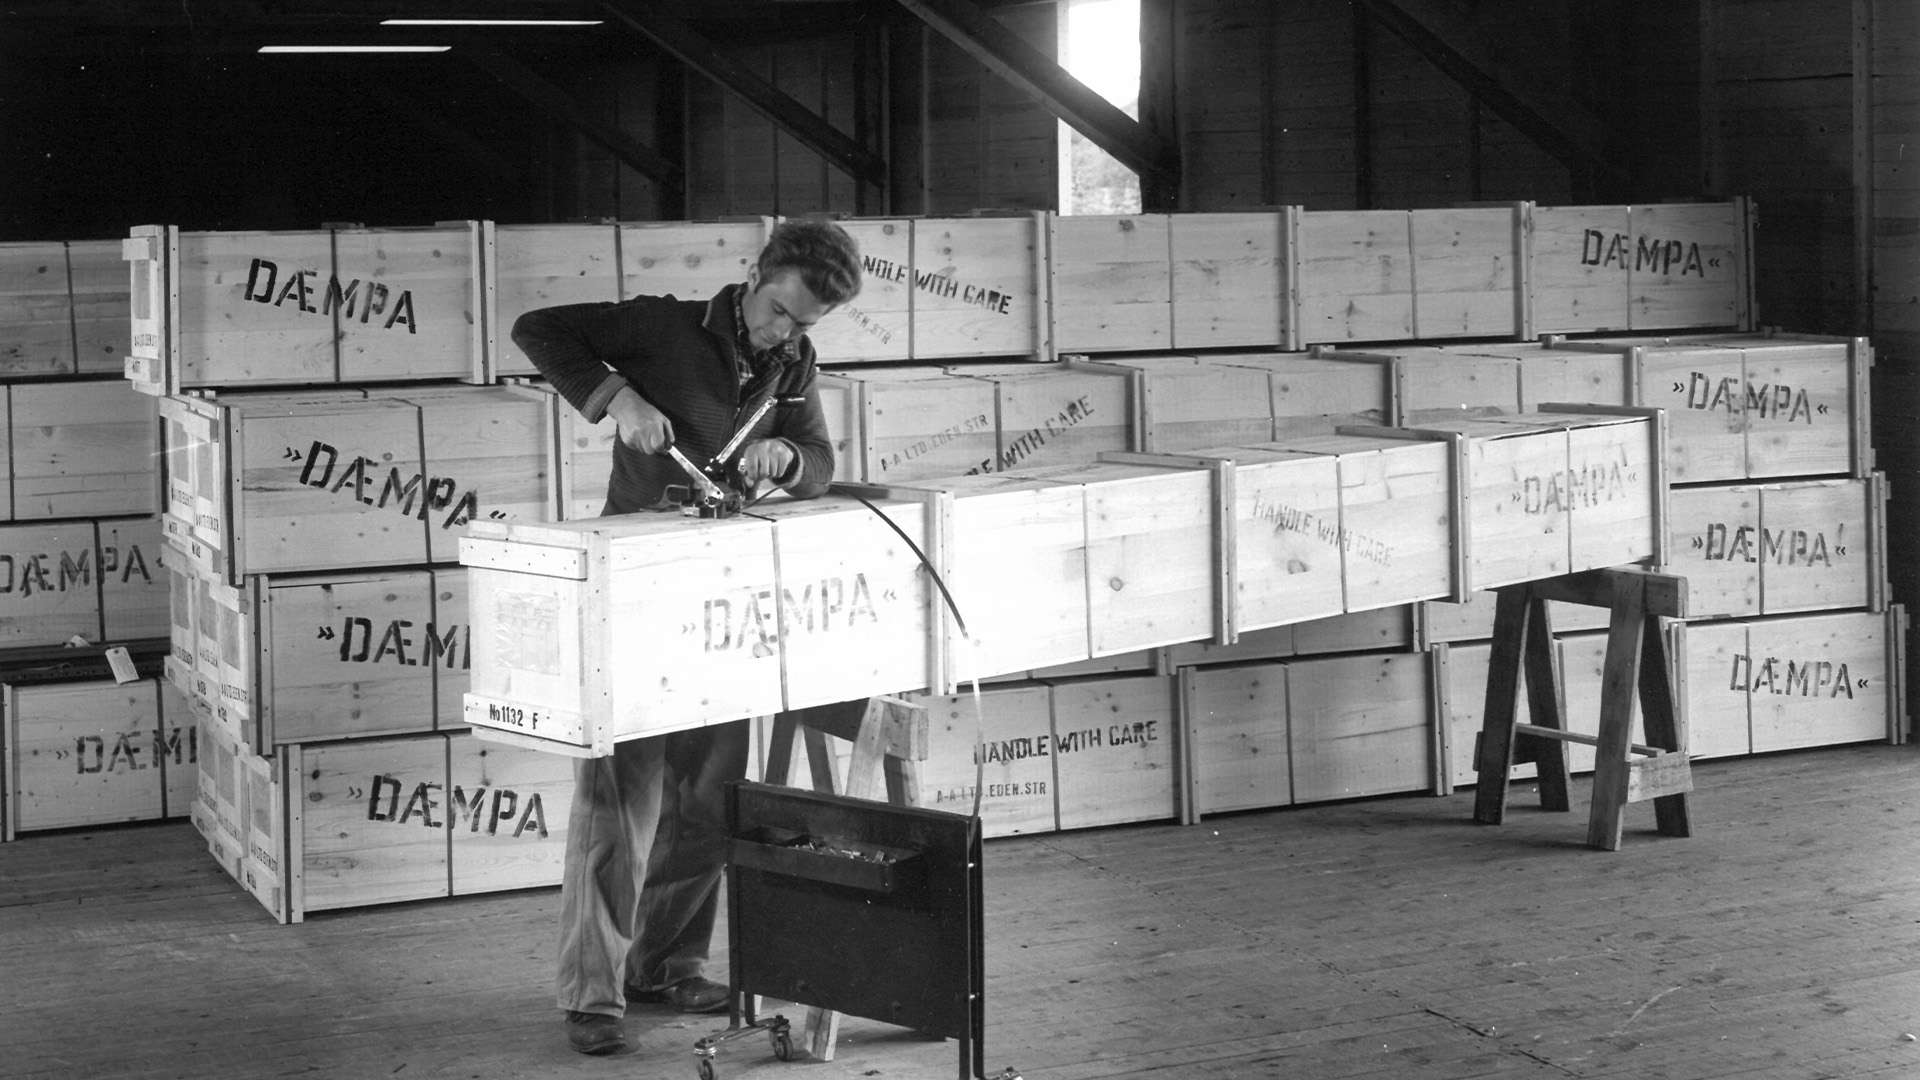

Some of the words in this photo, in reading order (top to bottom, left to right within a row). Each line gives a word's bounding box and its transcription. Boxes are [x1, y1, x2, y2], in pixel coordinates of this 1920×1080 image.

[244, 257, 417, 335] DÆMPA
[863, 255, 908, 285] NDLE
[914, 269, 959, 299] WITH
[1000, 428, 1045, 468] WITH
[1252, 503, 1313, 536] HANDLE
[1317, 518, 1353, 553] WITH
[532, 712, 539, 730] F
[973, 735, 1050, 765] HANDLE
[1054, 728, 1102, 754] WITH
